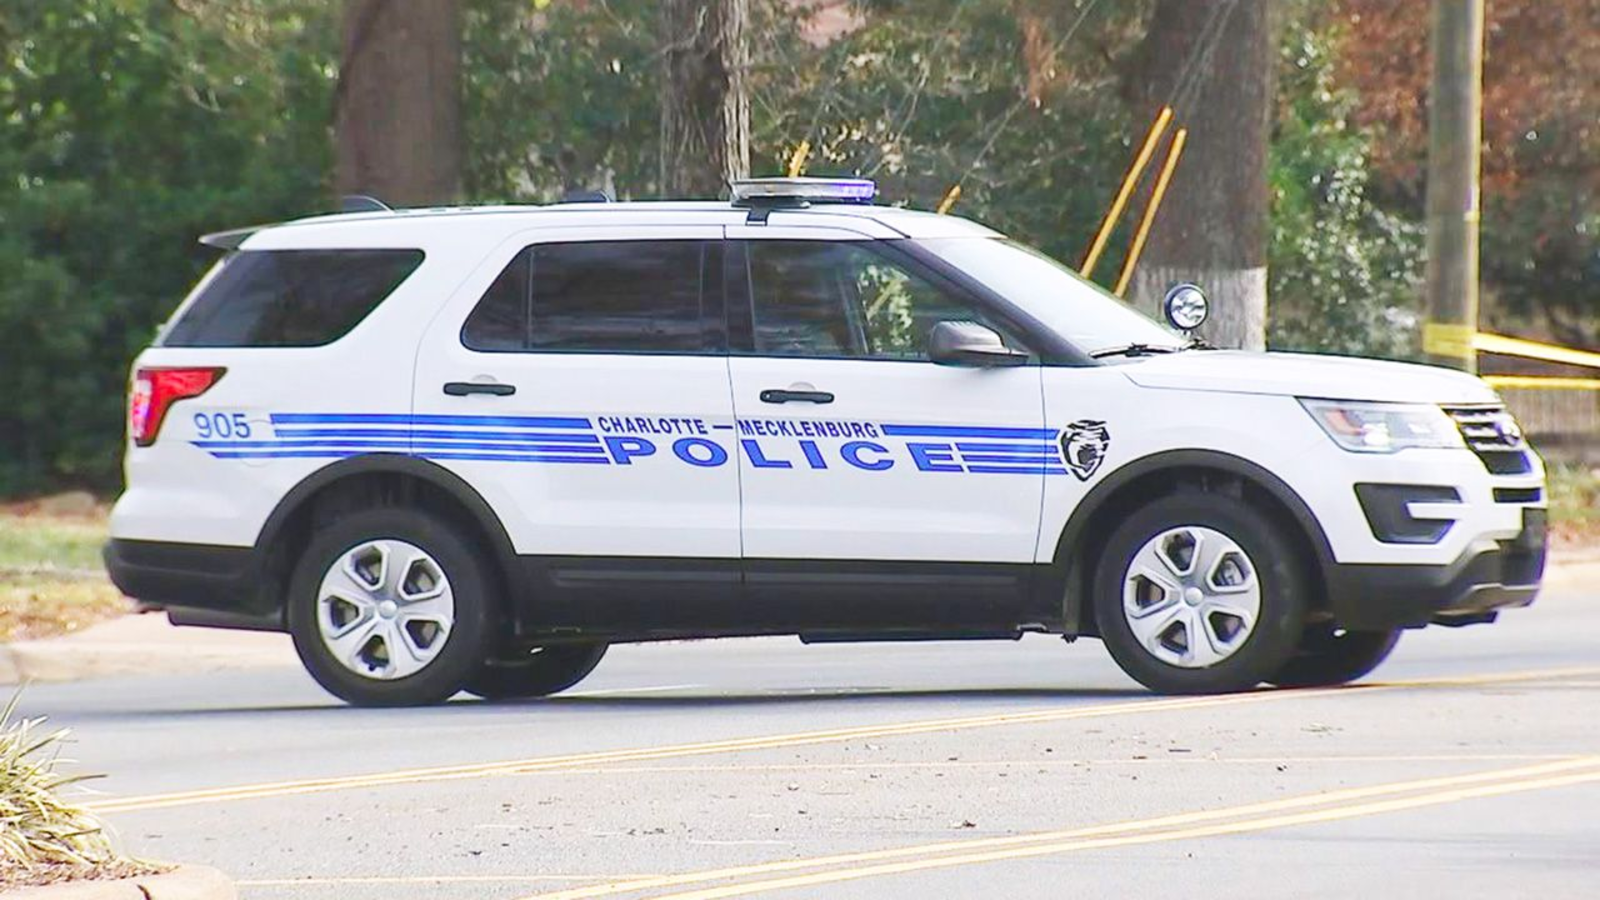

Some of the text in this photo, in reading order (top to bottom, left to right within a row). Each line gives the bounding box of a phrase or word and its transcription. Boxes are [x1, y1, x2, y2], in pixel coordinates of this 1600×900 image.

[194, 412, 250, 438] 905
[598, 416, 708, 435] CHARLOTTE
[736, 419, 878, 439] MECKLENBURG
[603, 436, 965, 473] POLICE
